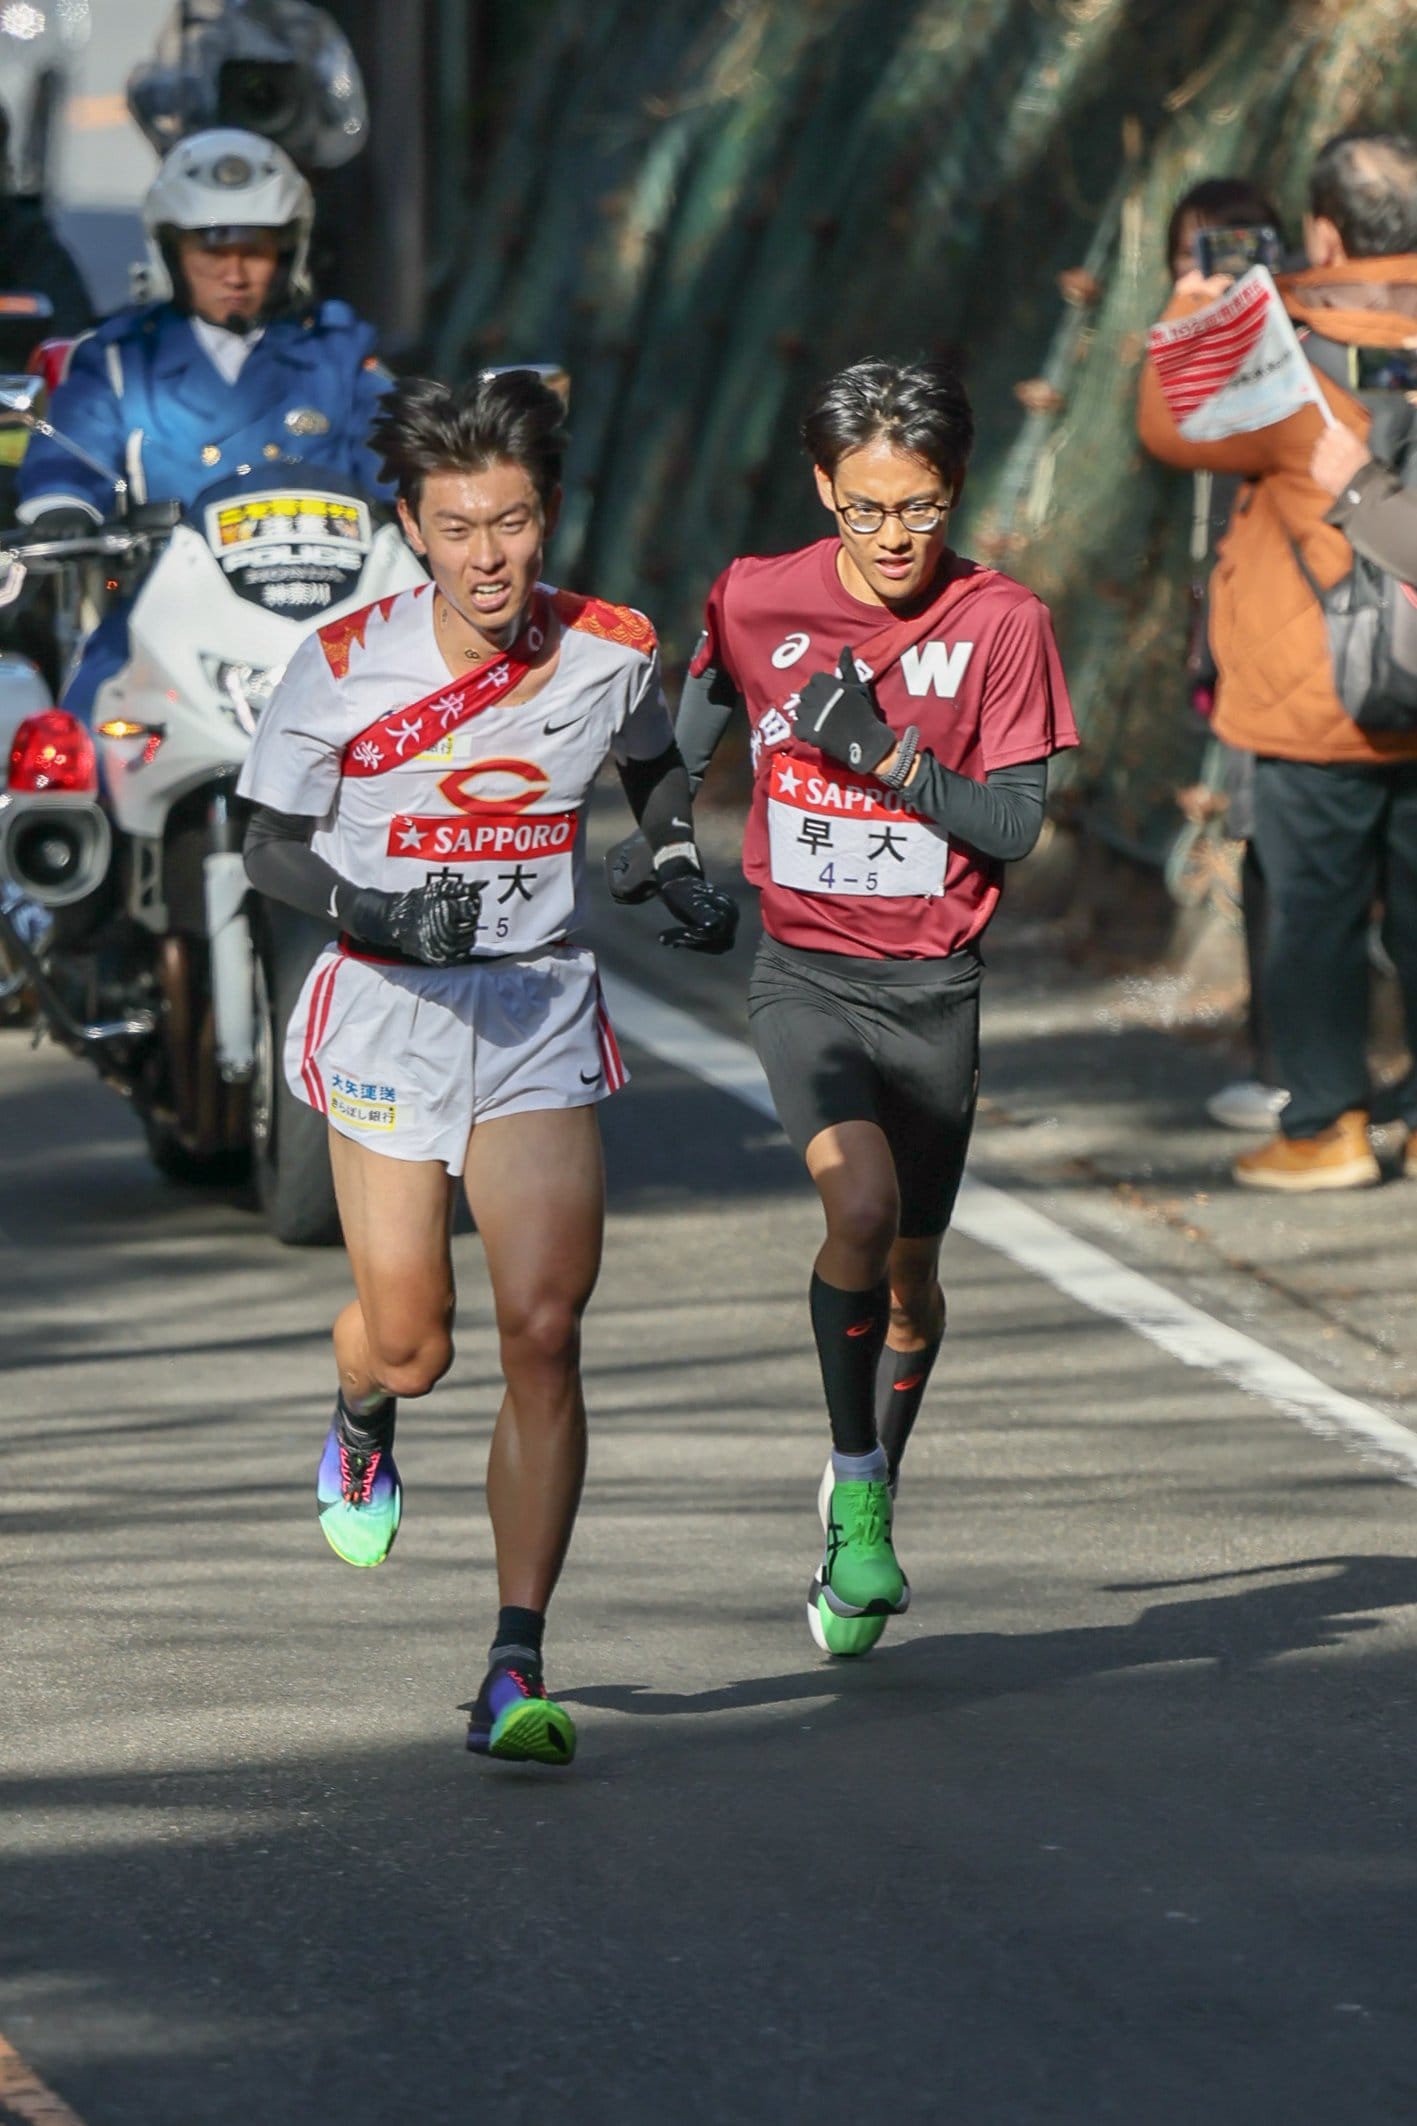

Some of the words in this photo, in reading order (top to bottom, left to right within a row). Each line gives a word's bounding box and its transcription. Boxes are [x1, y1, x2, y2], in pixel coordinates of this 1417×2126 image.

[899, 640, 974, 698] W
[436, 757, 551, 815] C
[433, 822, 571, 854] SAPPORO
[796, 817, 908, 863] 早大
[818, 862, 879, 891] 4-5
